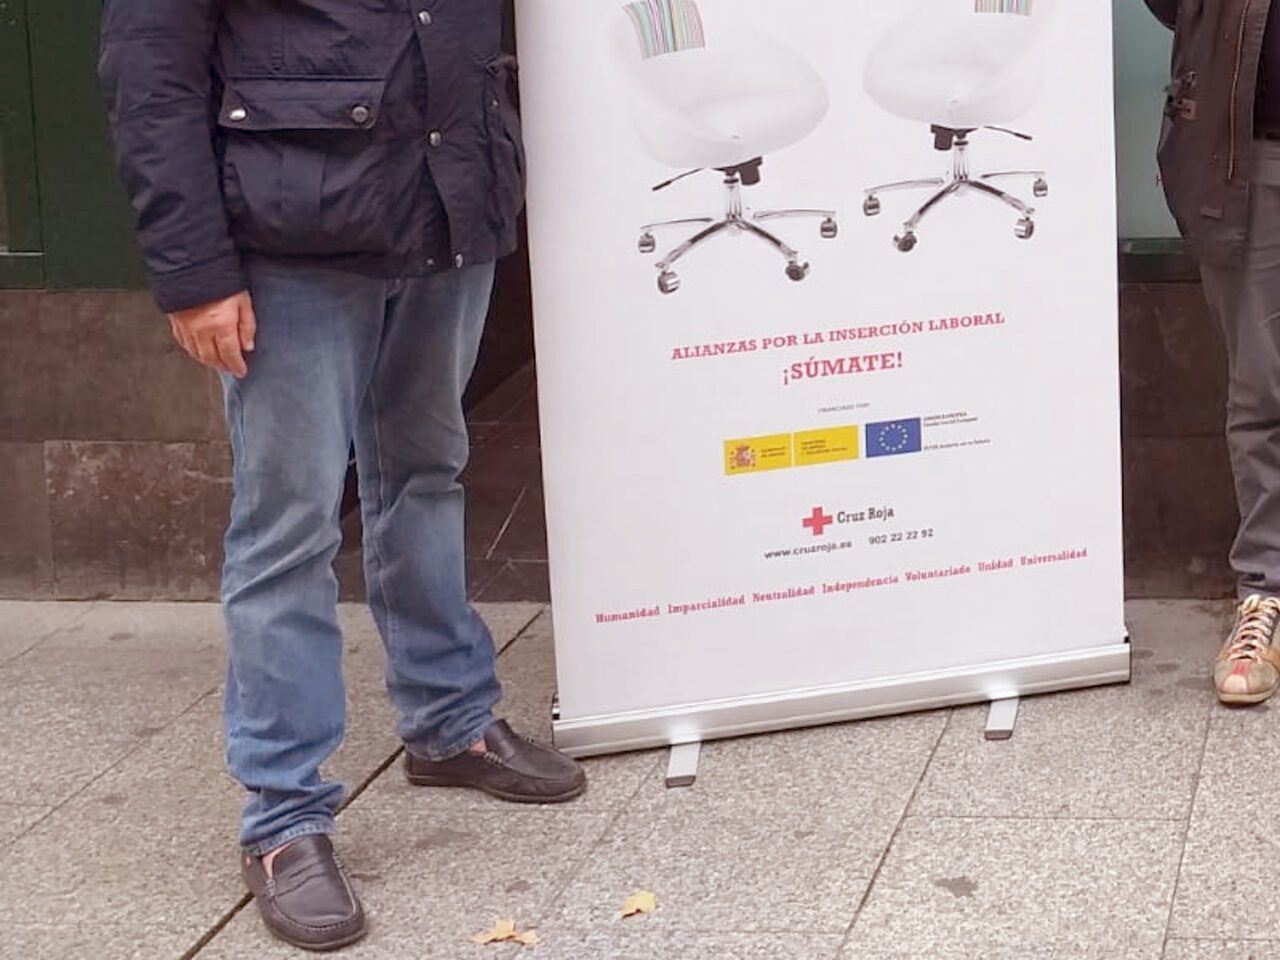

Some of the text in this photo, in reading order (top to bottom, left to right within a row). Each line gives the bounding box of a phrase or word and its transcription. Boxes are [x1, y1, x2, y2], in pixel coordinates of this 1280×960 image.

[672, 312, 1006, 360] ALIANZAS POR LA INSERCIÓN LABORAL
[783, 351, 903, 385] ¡SÚMATE!
[837, 507, 894, 524] Cruz Roja
[764, 540, 852, 560] www.cruzroja.es
[869, 535, 888, 546] 902
[891, 533, 903, 543] 22
[907, 530, 918, 540] 22
[596, 548, 1088, 624] Humanidad Imparcialidad Neutralidad Independencia Voluntariado Unidad Universalidad
